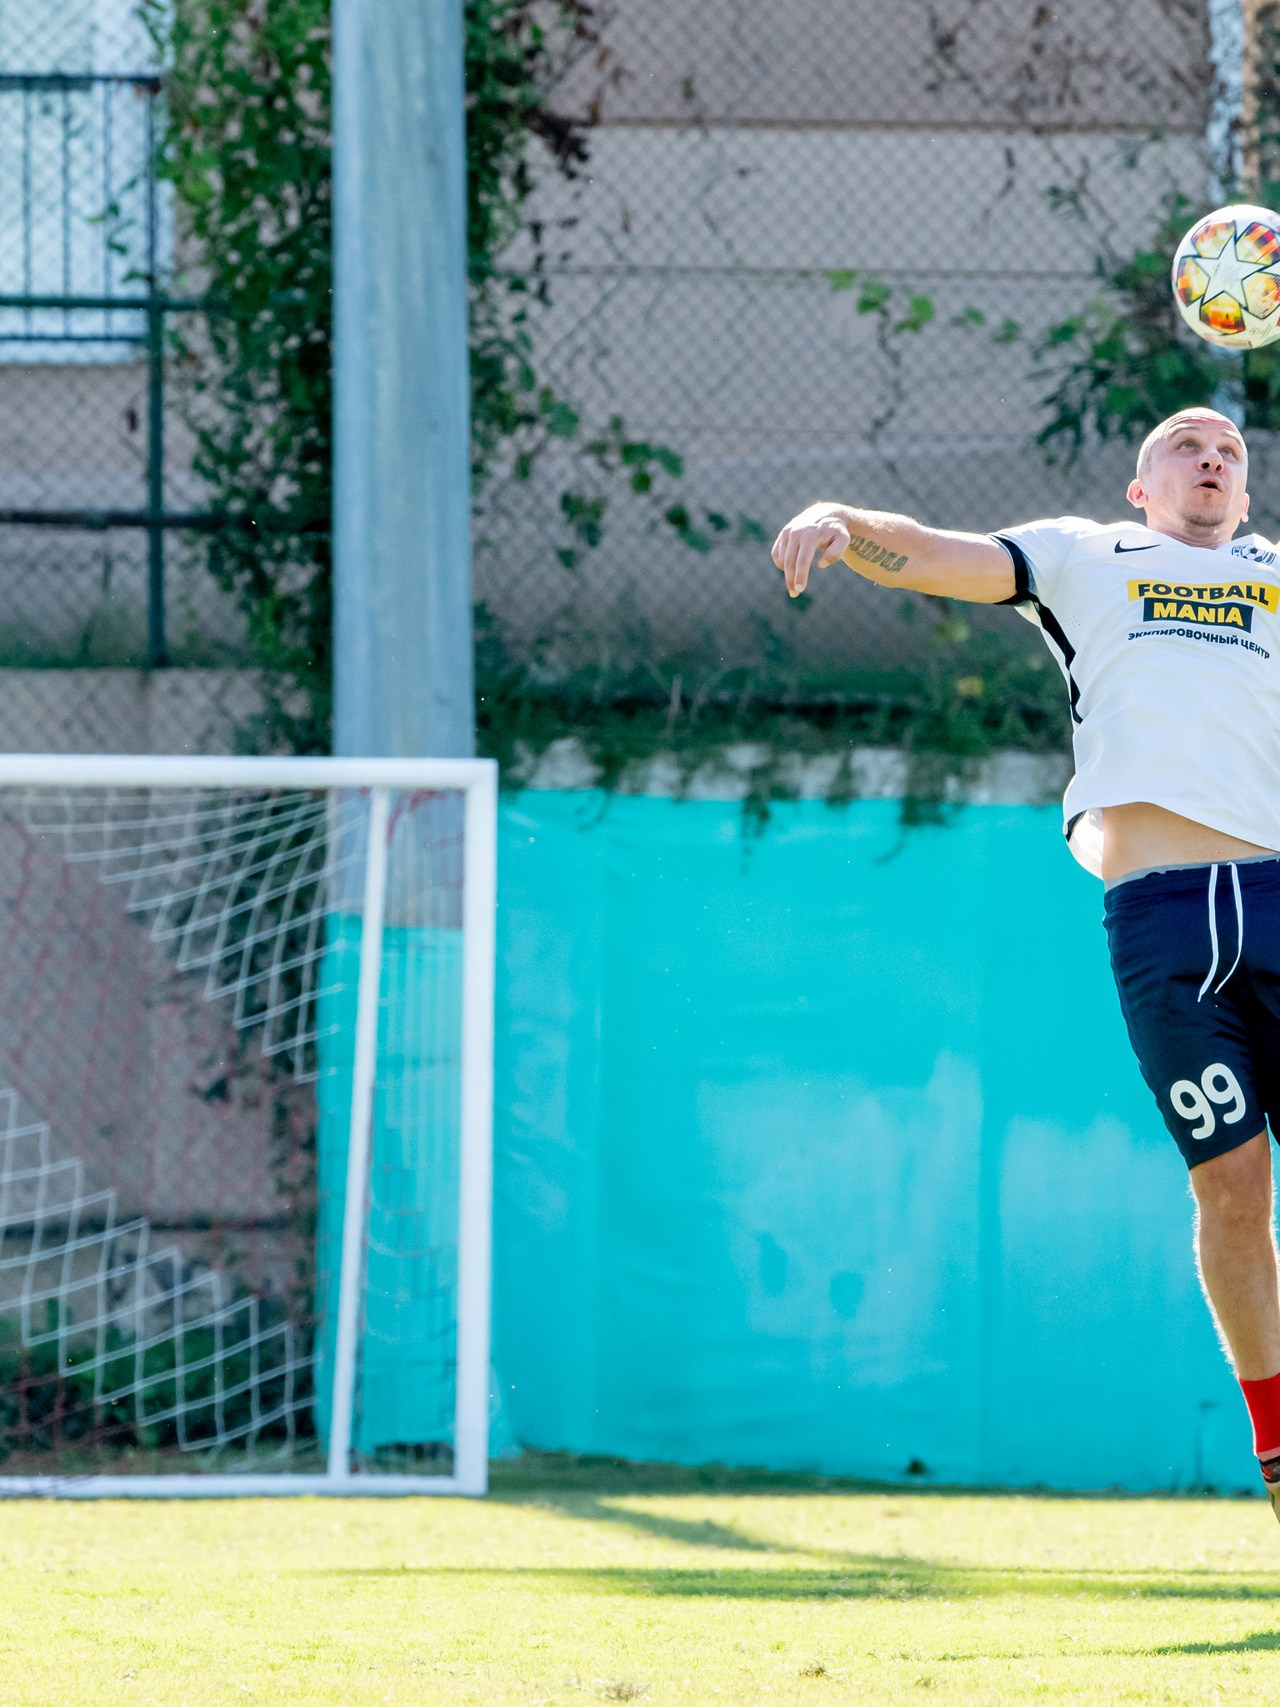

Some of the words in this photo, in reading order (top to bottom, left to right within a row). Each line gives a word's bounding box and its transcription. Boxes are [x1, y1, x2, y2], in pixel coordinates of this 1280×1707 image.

[1138, 583, 1270, 606] FOOTBALL
[1153, 602, 1244, 627] MANIA
[1128, 628, 1239, 646] ЭКИПИРОВОЧНЫЙ
[1240, 639, 1270, 660] ЦЕНТР
[1169, 1062, 1247, 1140] 99
